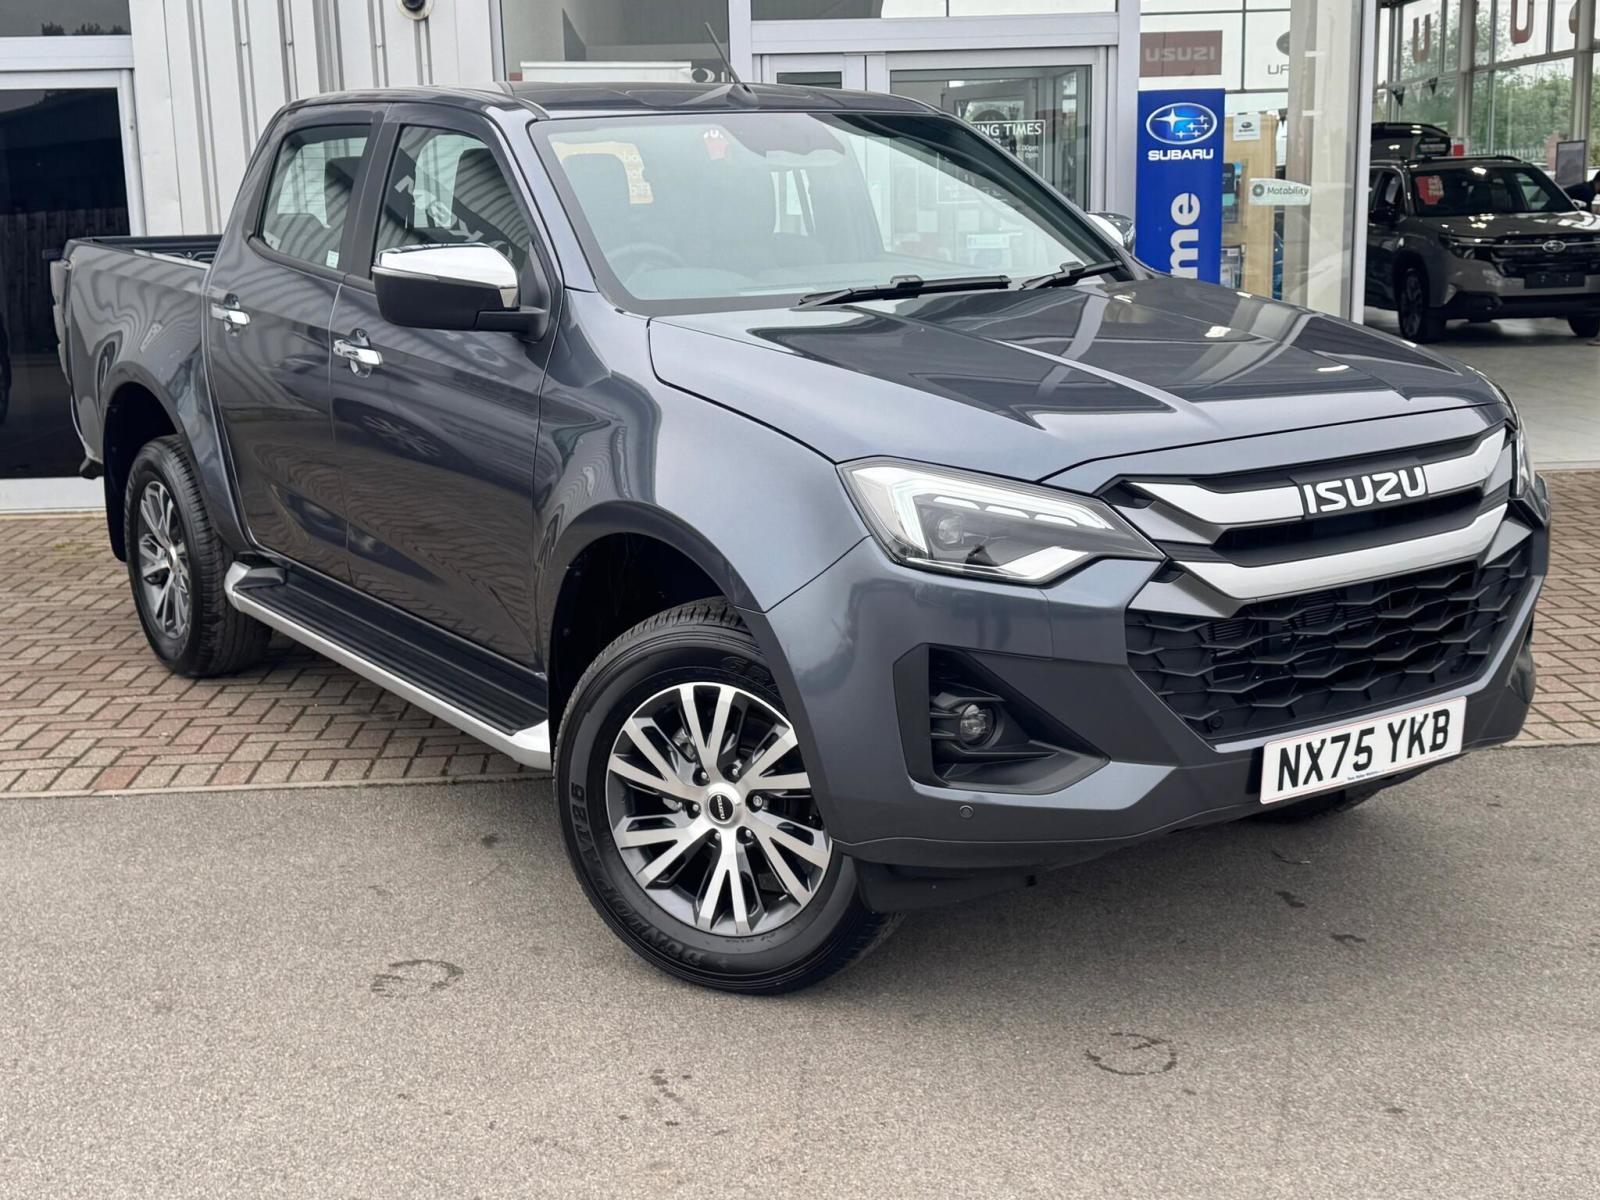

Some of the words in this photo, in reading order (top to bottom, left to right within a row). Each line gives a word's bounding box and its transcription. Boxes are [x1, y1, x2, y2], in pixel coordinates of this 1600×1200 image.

[1003, 123, 1042, 135] TIMES
[1148, 148, 1214, 161] SUBARU
[1267, 184, 1309, 196] Motability
[1303, 466, 1426, 514] ISUZU
[1277, 727, 1375, 791] NX75
[1388, 708, 1451, 763] YKB
